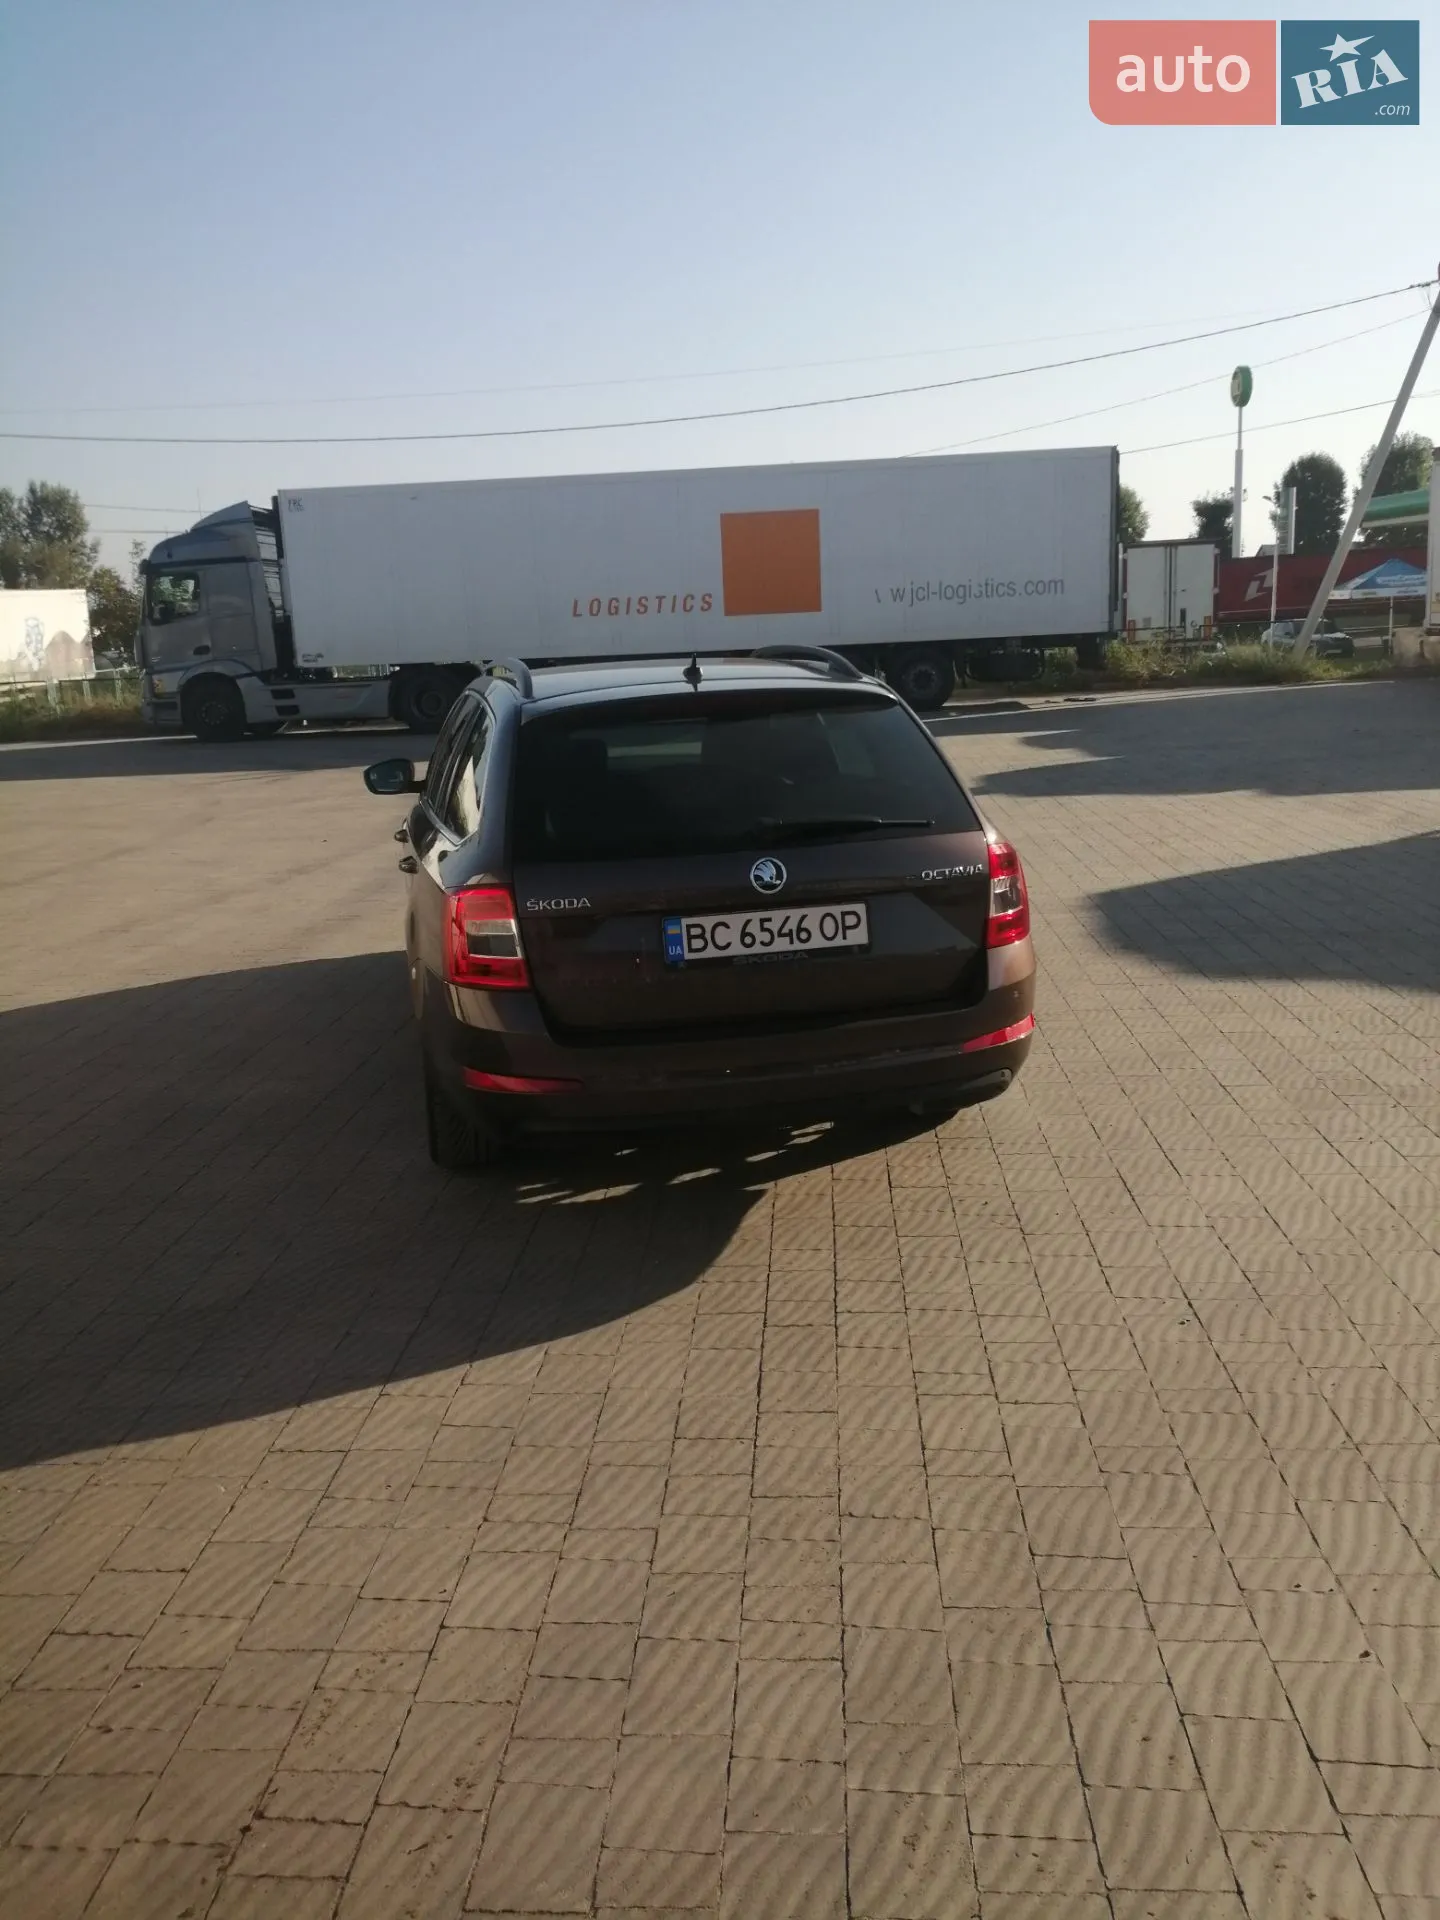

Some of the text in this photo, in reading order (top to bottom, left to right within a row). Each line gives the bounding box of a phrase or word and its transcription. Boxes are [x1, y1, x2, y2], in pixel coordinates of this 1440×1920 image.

[571, 593, 713, 618] LOGISTICS
[921, 864, 983, 881] OCTAVIA
[685, 910, 862, 954] BC 6546 OP
[668, 945, 683, 956] UA
